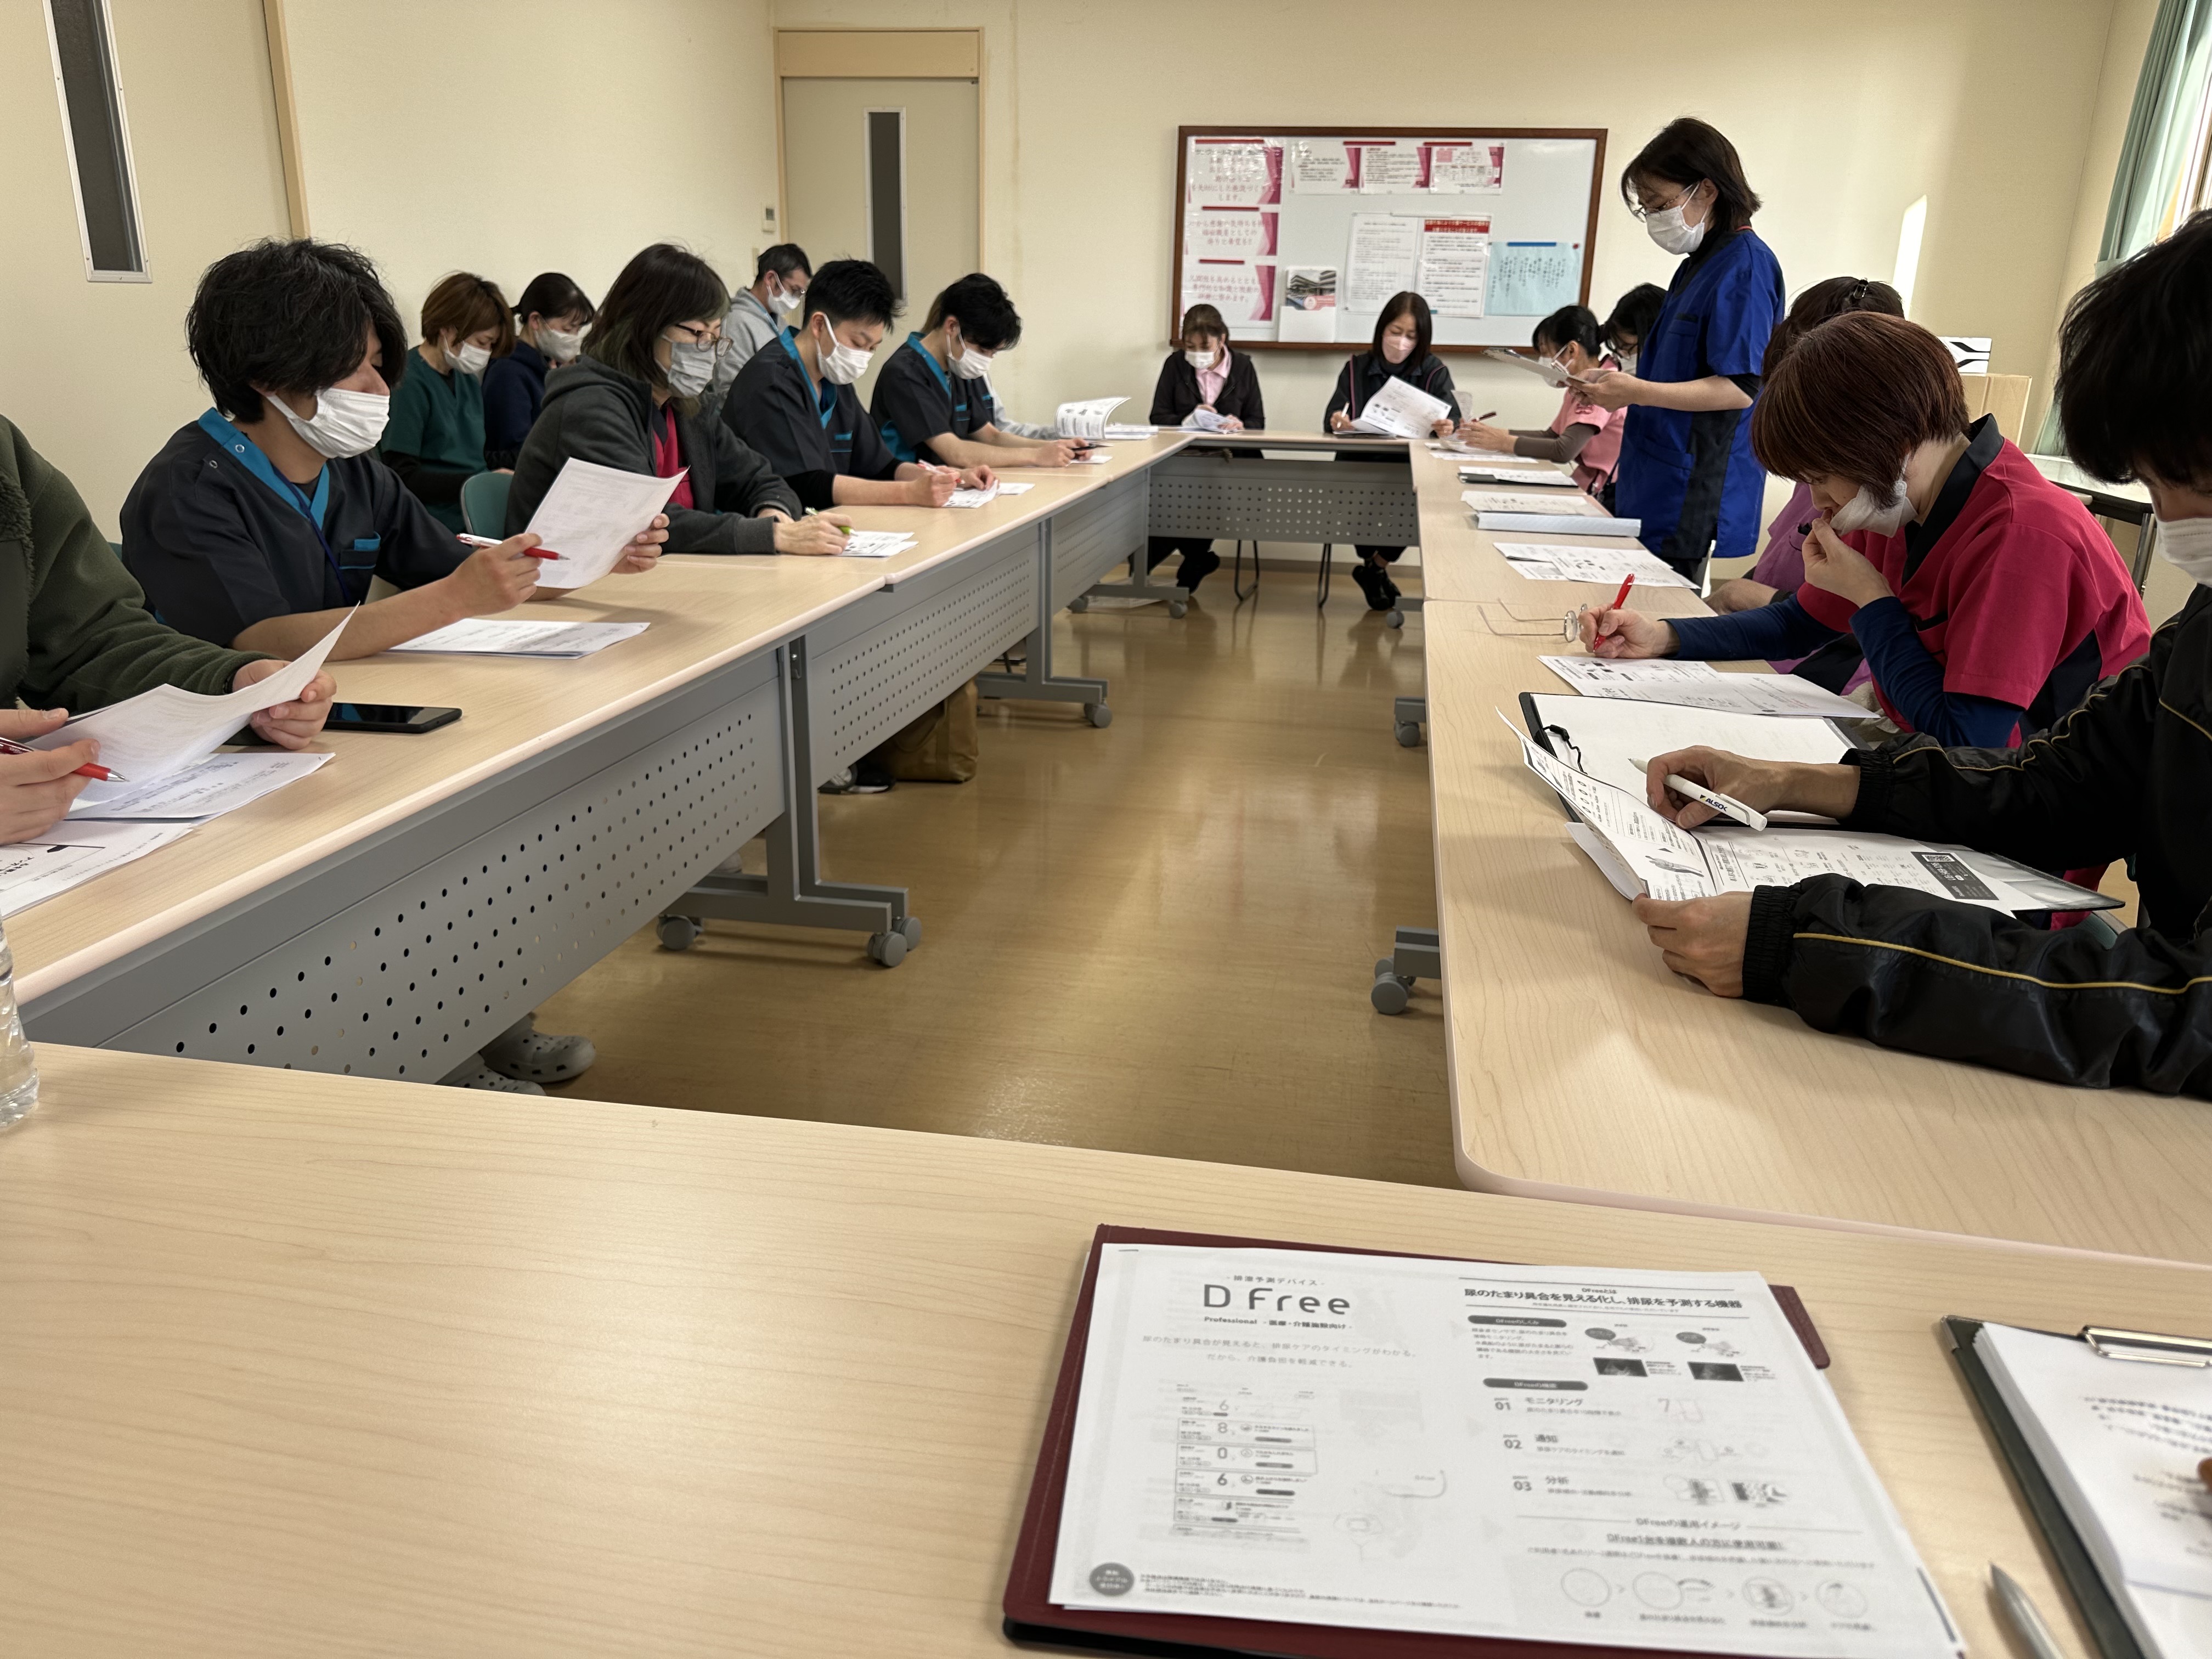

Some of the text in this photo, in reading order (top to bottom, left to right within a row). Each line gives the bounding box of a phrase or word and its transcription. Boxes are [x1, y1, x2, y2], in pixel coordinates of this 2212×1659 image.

[1705, 798, 1728, 811] ALSOK
[1204, 1316, 1257, 1324] Professional
[1495, 1402, 1510, 1410] 01
[1526, 1397, 1583, 1406] モニタリング
[1218, 1422, 1228, 1434] 8
[1535, 1434, 1559, 1443] 通知
[1504, 1439, 1522, 1449] 02
[1217, 1473, 1228, 1486] 6
[1514, 1481, 1532, 1491] 03
